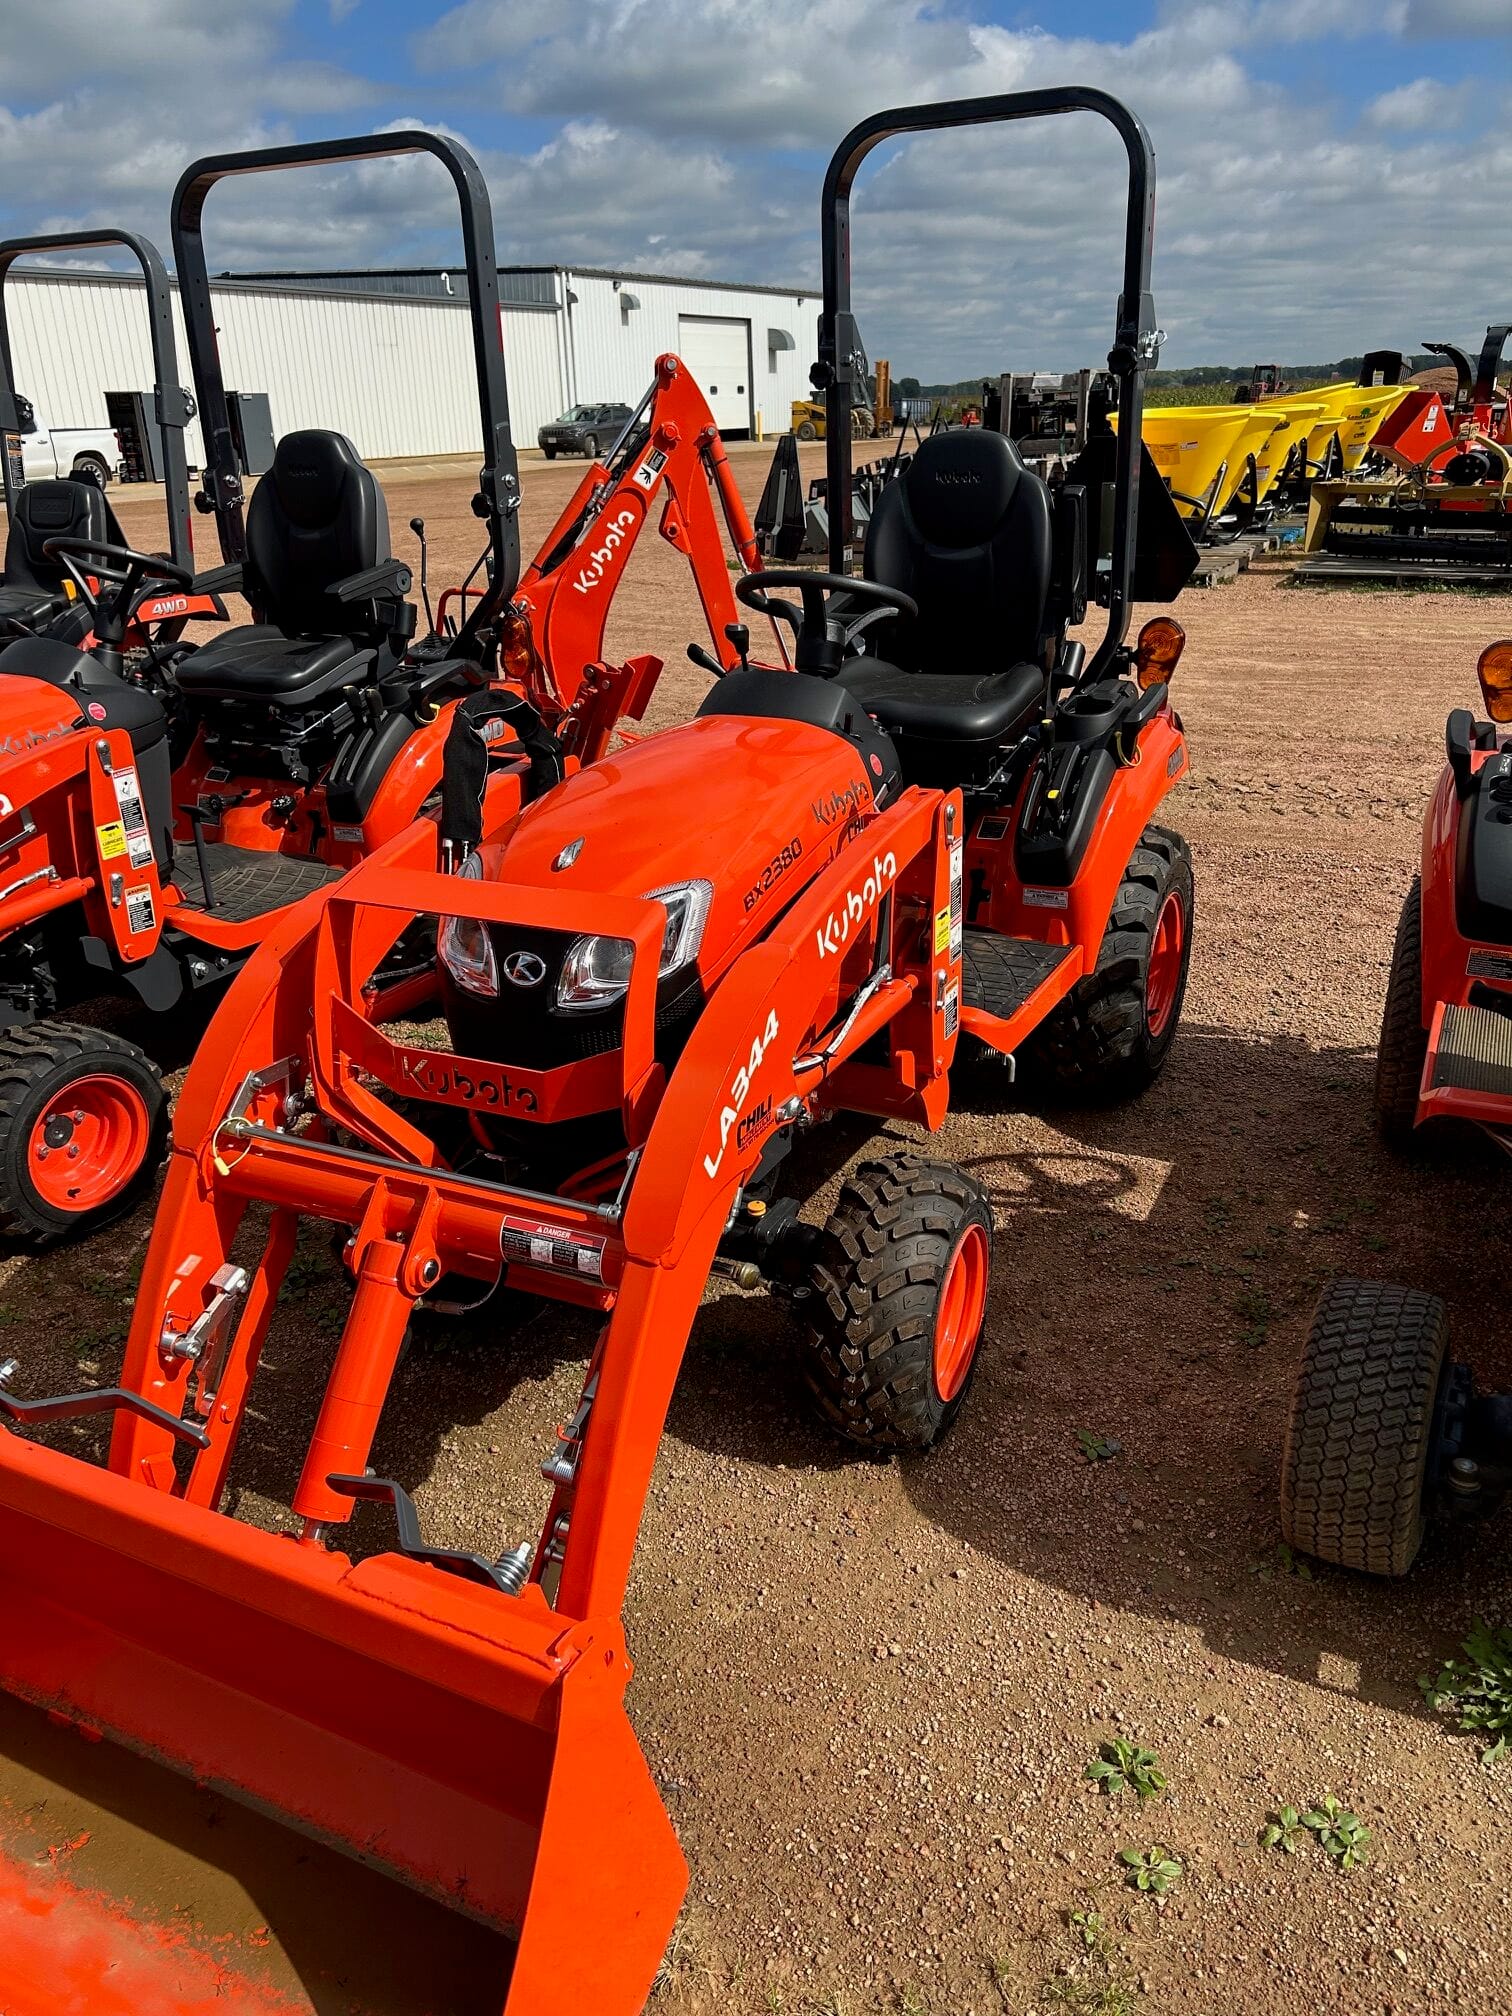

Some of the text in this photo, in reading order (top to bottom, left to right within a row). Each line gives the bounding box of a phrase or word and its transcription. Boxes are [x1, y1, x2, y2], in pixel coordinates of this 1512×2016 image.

[572, 510, 636, 594] Kubota
[152, 598, 188, 615] 4WD
[0, 721, 75, 756] Kubot
[474, 720, 504, 743] WD
[811, 778, 870, 826] Kubota
[742, 836, 804, 914] BX2380
[816, 850, 897, 959] Kubota
[401, 1055, 539, 1113] Kubota
[703, 1007, 780, 1180] LA344
[736, 1093, 774, 1149] CHILI
[543, 1227, 572, 1240] DANGER
